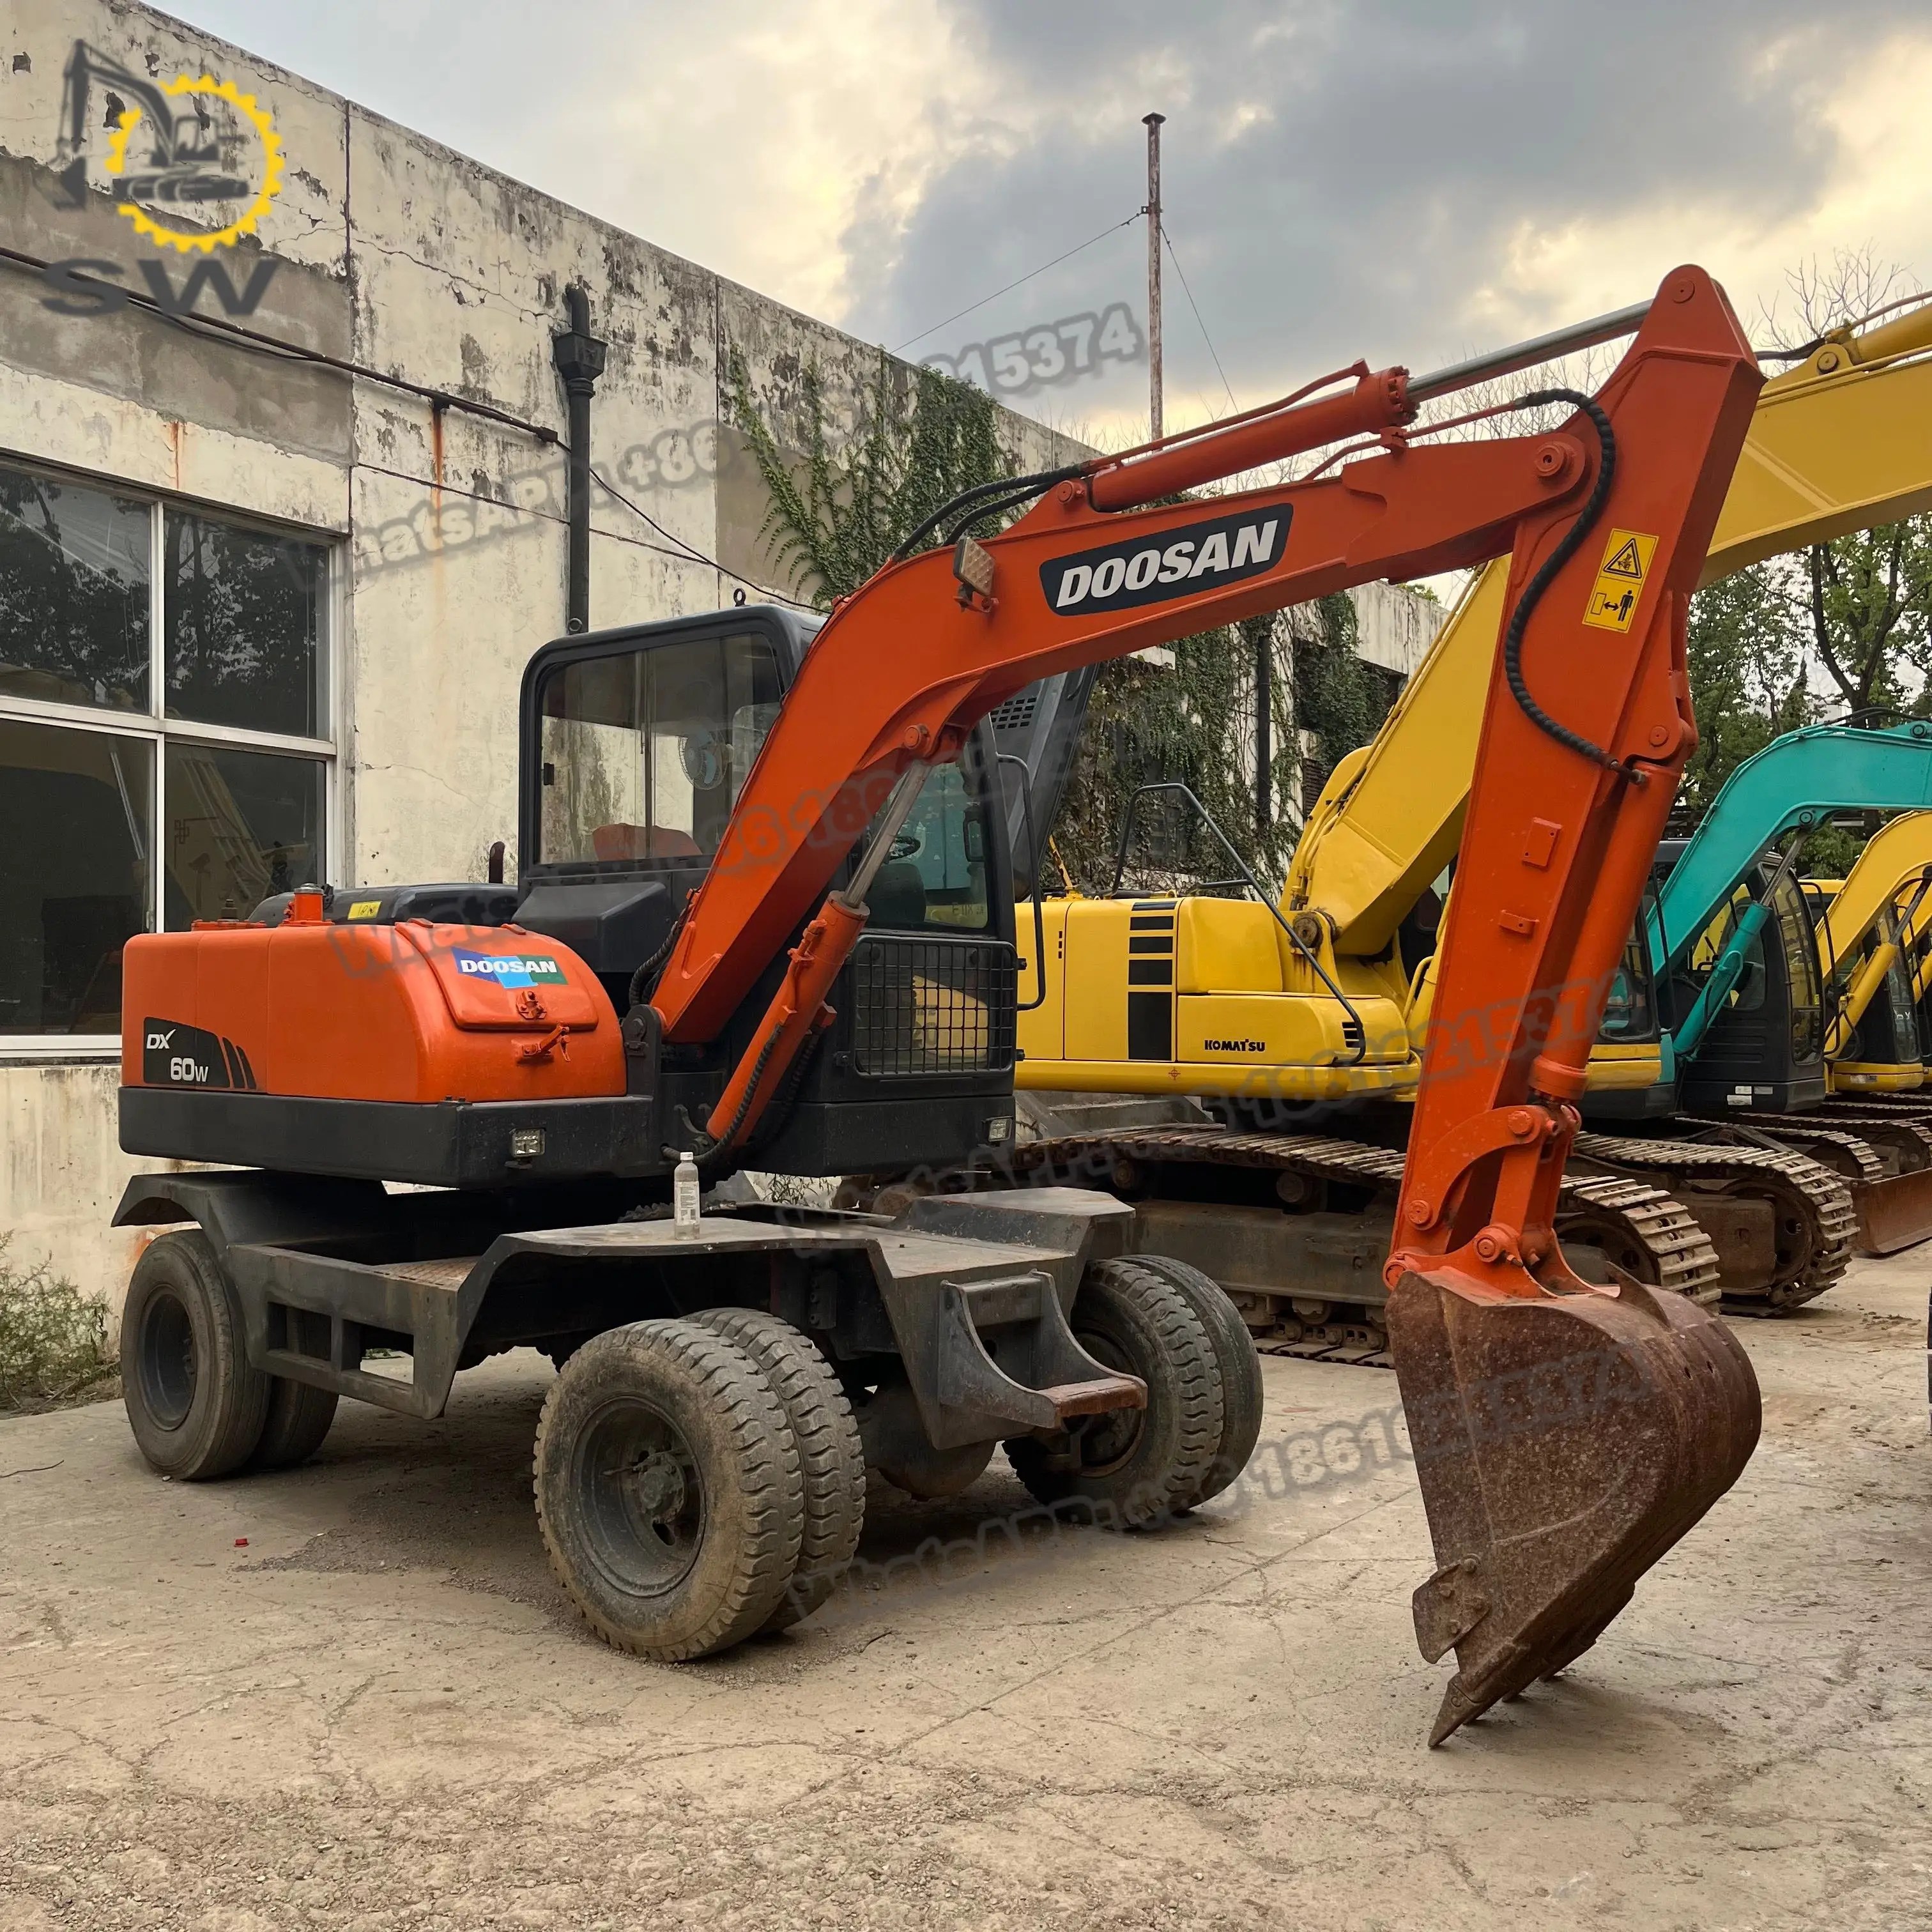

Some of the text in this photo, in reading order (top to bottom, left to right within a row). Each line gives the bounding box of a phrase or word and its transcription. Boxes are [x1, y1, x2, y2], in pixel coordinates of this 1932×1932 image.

[1056, 519, 1278, 608] DOOSAN
[461, 960, 557, 974] DOOSAN
[146, 1029, 176, 1049] DX
[1204, 1038, 1266, 1052] KOMATSU
